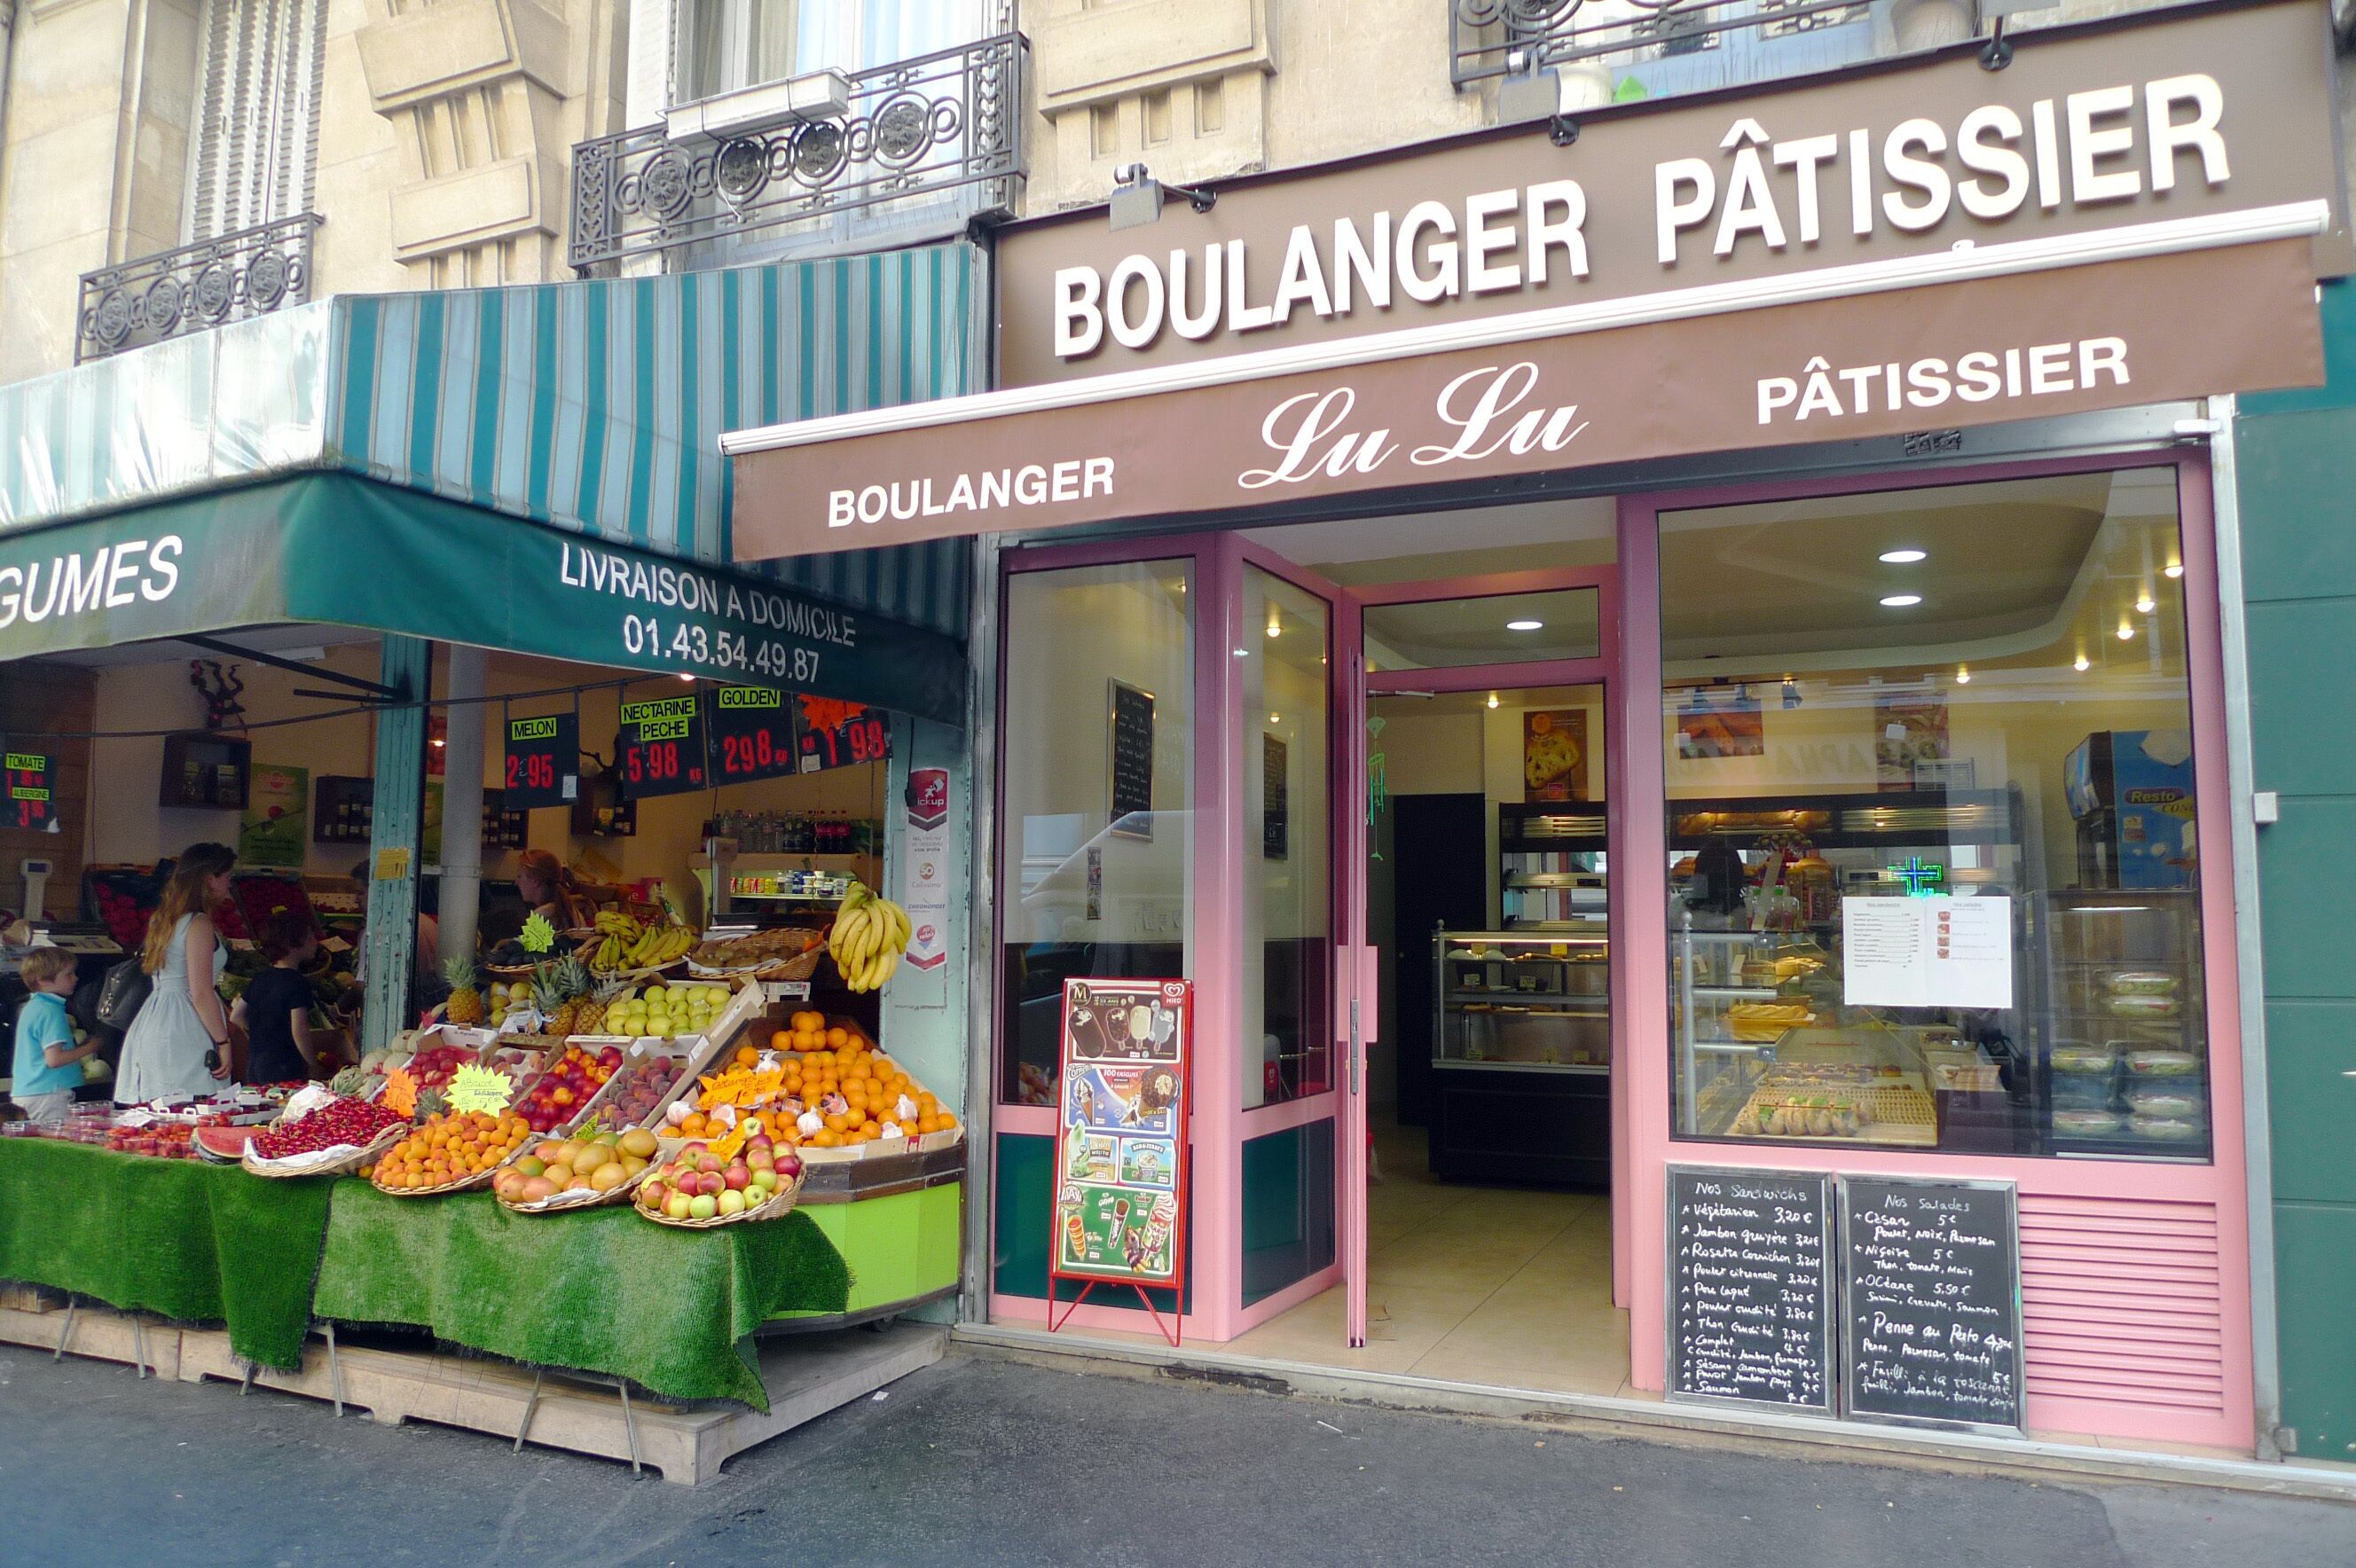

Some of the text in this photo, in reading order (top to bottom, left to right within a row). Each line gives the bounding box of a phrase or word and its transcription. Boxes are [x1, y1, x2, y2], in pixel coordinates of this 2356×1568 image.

[1054, 74, 2230, 357] BOULANGER PÂTISSIER
[1756, 337, 2131, 425] PÂTISSIER
[1237, 361, 1590, 489] Lu Lu
[829, 457, 1115, 528] BOULANGER
[561, 542, 857, 648] LIVRAISON A DOMICILE
[624, 614, 821, 683] 01.43.54.49.87
[722, 690, 778, 705] GOLDEN
[624, 699, 693, 721] NECTARINE
[514, 721, 554, 737] MELON
[643, 723, 685, 738] PECHE
[8, 756, 44, 769] TOMATE
[915, 797, 945, 807] ickup
[2132, 790, 2175, 803] Resto
[1696, 1182, 1807, 1202] Nos Sandwichs
[1884, 1194, 1907, 1208] Nos
[1692, 1223, 1737, 1240] Jambon
[1693, 1263, 1727, 1279] Poulet
[1698, 1316, 1724, 1329] Thon
[1873, 1311, 1914, 1337] Penne
[1921, 1325, 1941, 1337] au
[1695, 1334, 1734, 1349] Complet
[1694, 1381, 1740, 1394] Saumon
